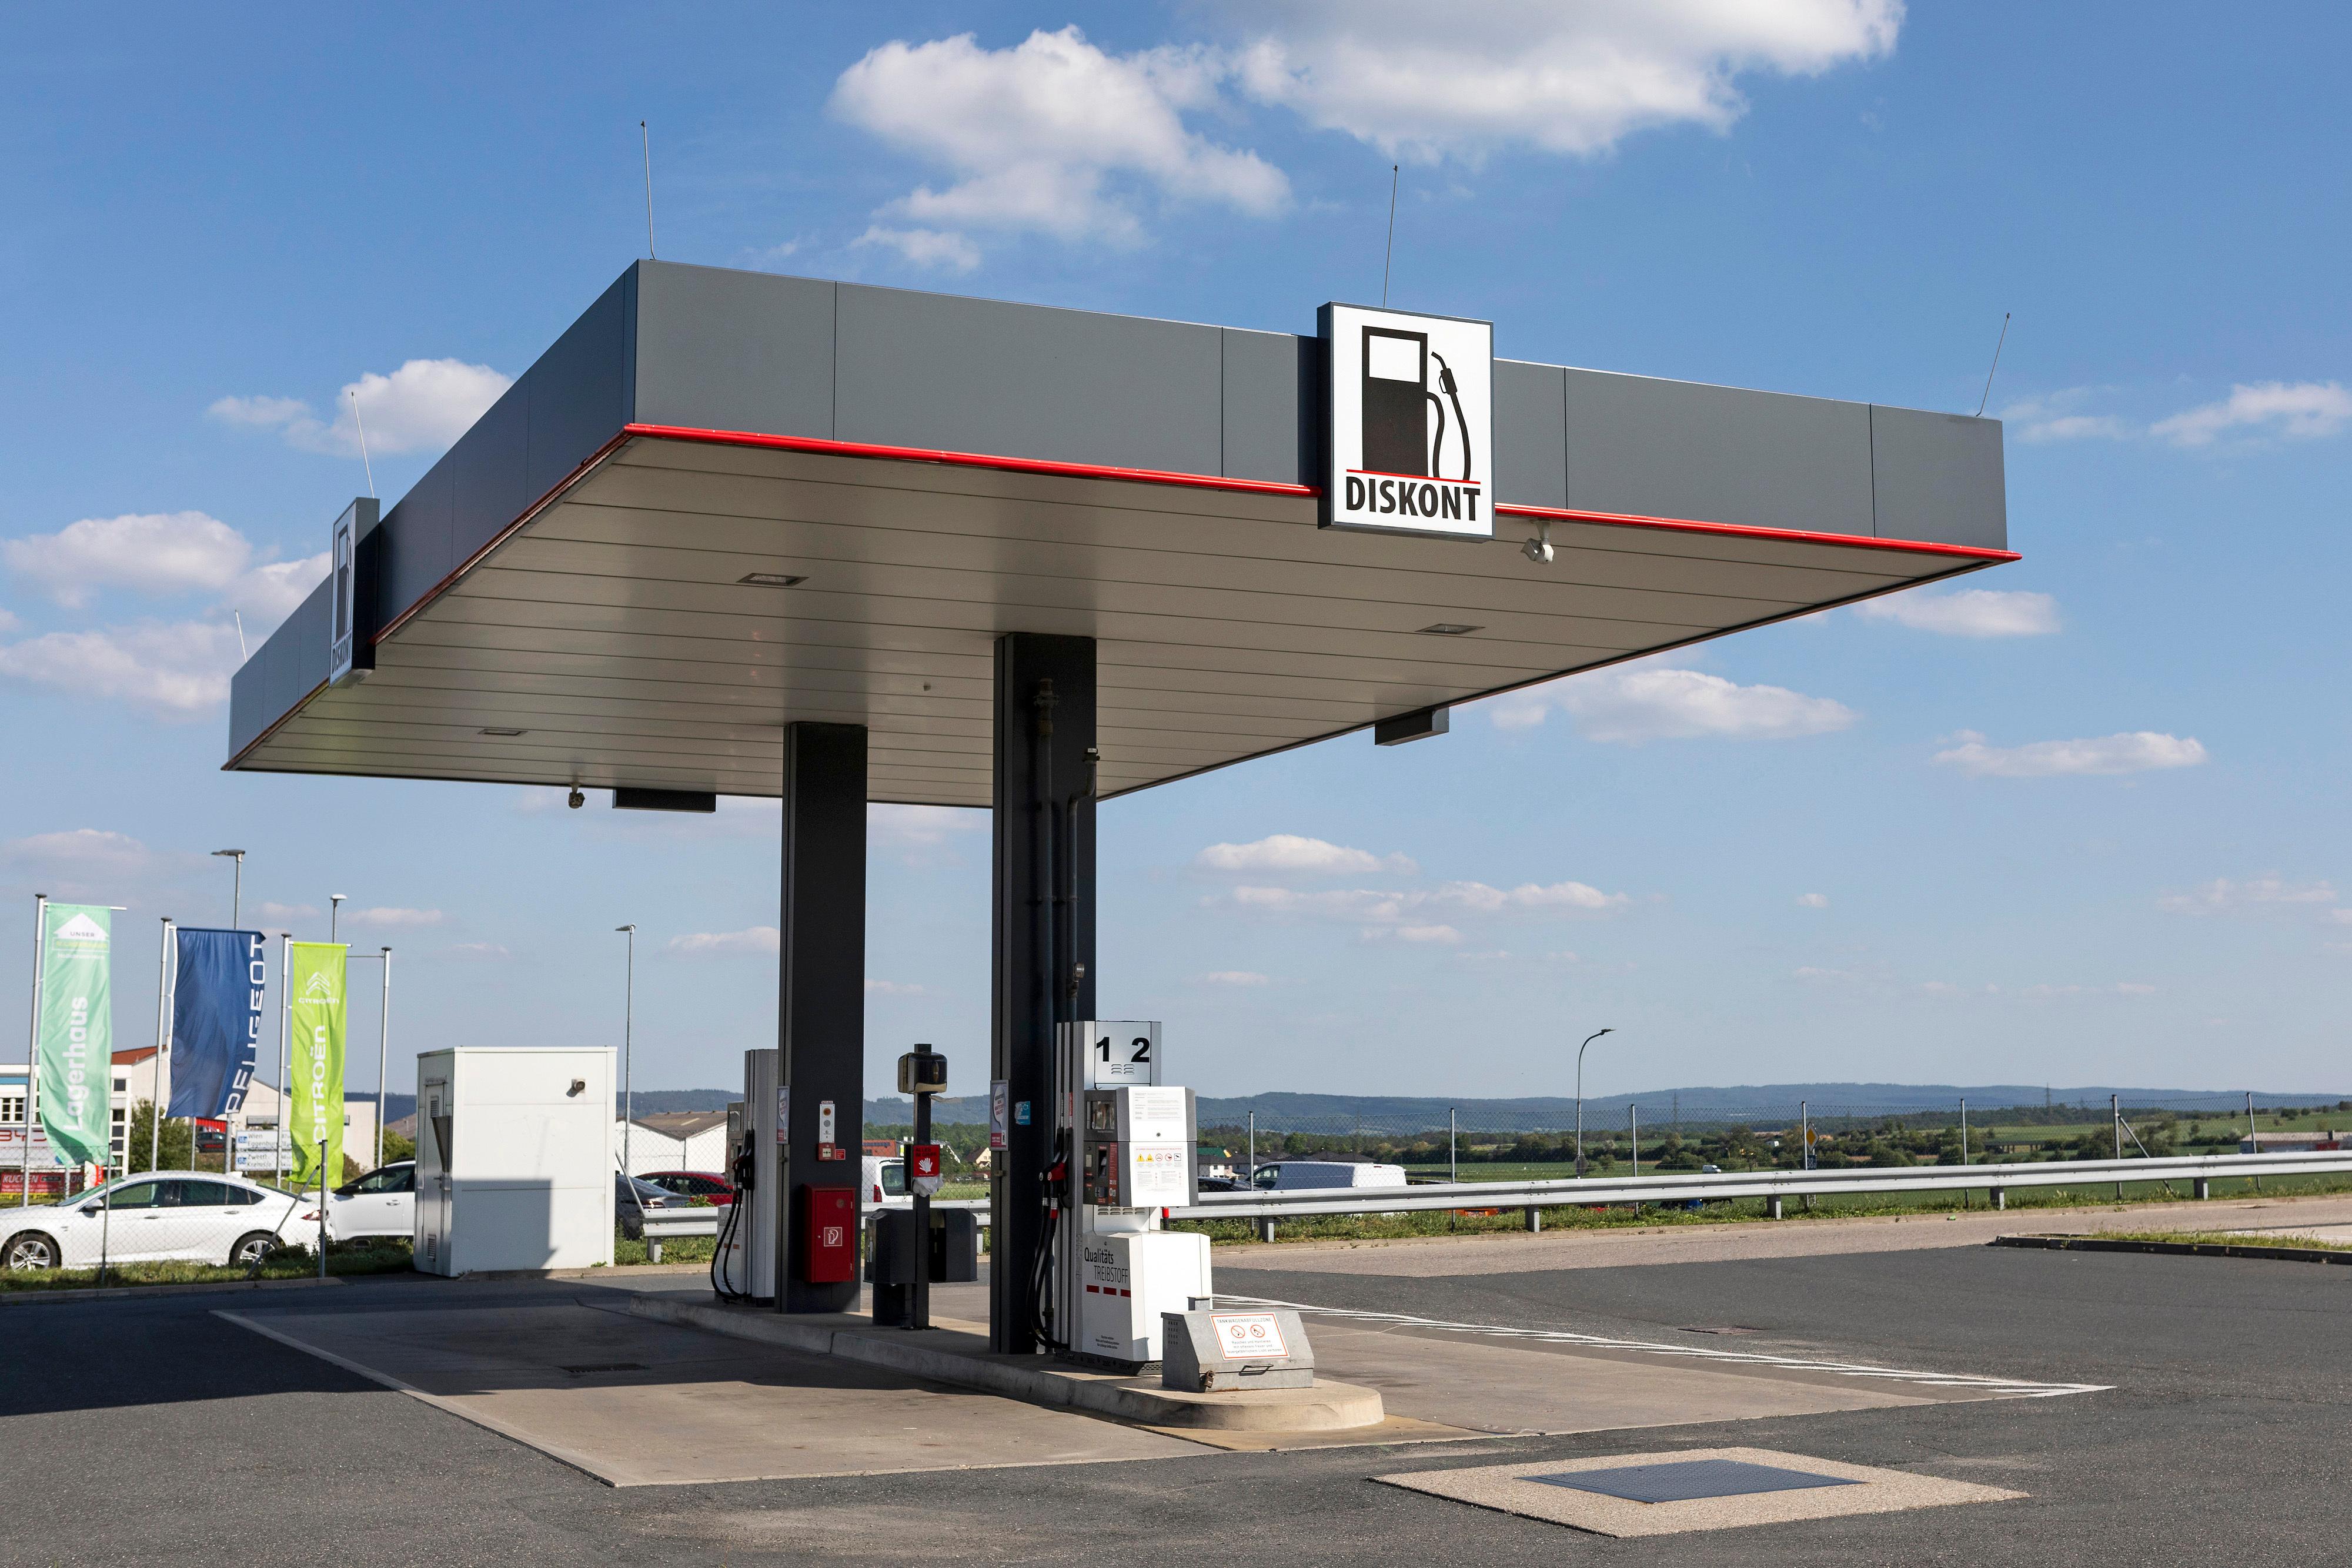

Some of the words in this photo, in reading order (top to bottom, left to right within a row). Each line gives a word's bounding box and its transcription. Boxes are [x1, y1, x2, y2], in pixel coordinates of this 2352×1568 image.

[1346, 476, 1481, 521] DISKONT
[332, 632, 352, 674] DISKONT
[1096, 1037, 1110, 1062] 1
[1131, 1037, 1150, 1063] 2
[62, 997, 89, 1131] Lagerhaus
[1807, 1158, 1816, 1169] 38a
[1084, 1247, 1114, 1264] Qualitäts
[1094, 1265, 1128, 1283] TREIBSTOFF
